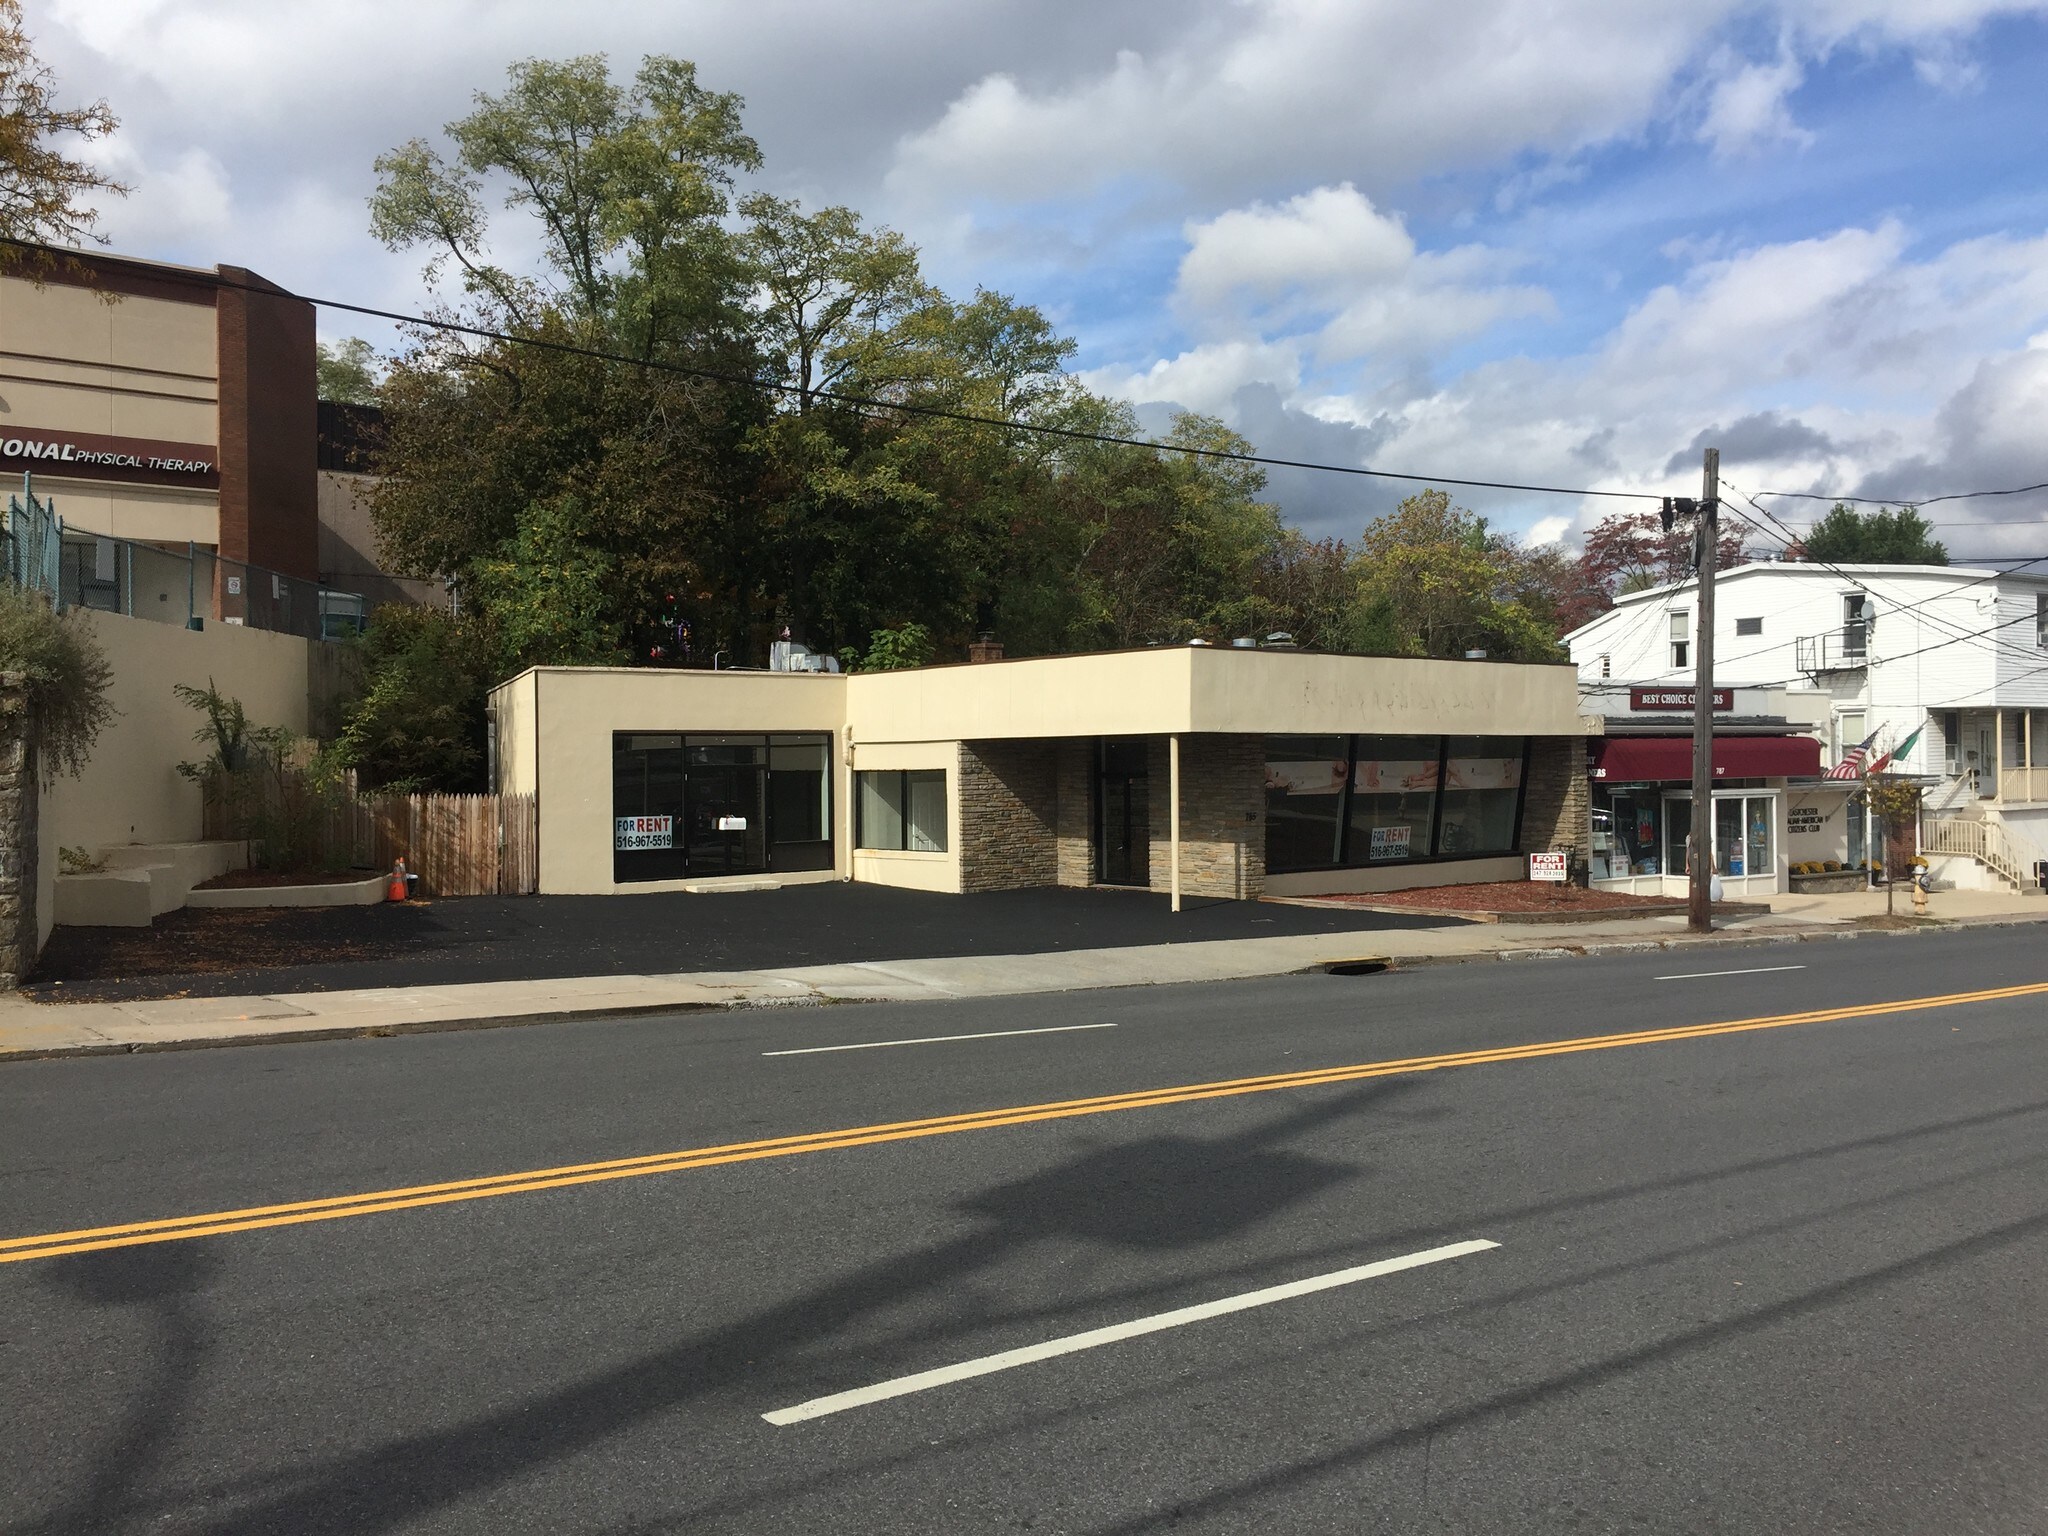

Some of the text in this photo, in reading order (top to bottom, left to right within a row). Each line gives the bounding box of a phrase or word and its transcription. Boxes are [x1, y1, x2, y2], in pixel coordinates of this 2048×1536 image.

[75, 450, 143, 467] PHYSICAL
[148, 457, 211, 473] THERAPY
[1642, 694, 1660, 704] BEST
[1661, 694, 1687, 704] CHOICE
[617, 818, 670, 832] FOR RENT
[617, 835, 671, 848] 516-967-5519
[1373, 828, 1410, 842] FOR RENT
[1371, 844, 1408, 857] 516-967-5519
[1536, 855, 1560, 863] FOR
[1533, 862, 1564, 870] RENT
